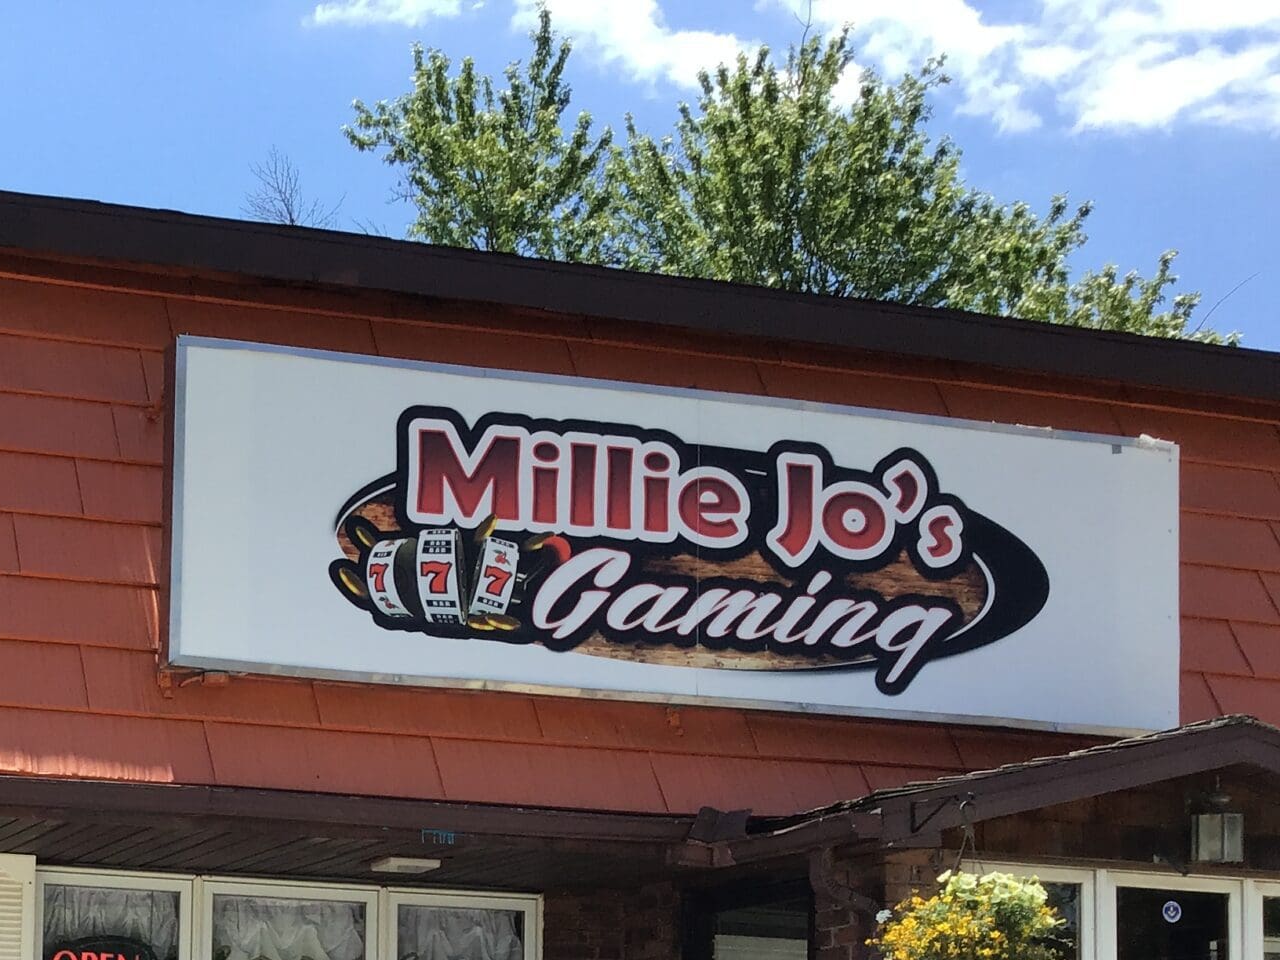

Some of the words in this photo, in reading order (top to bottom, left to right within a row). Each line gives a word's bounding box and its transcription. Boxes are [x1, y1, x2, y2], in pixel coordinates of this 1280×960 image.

[408, 418, 750, 547] Millie
[767, 453, 962, 568] Jo's
[370, 563, 389, 592] 7
[421, 561, 453, 594] 7
[484, 565, 512, 597] 7
[532, 549, 952, 683] Gaming
